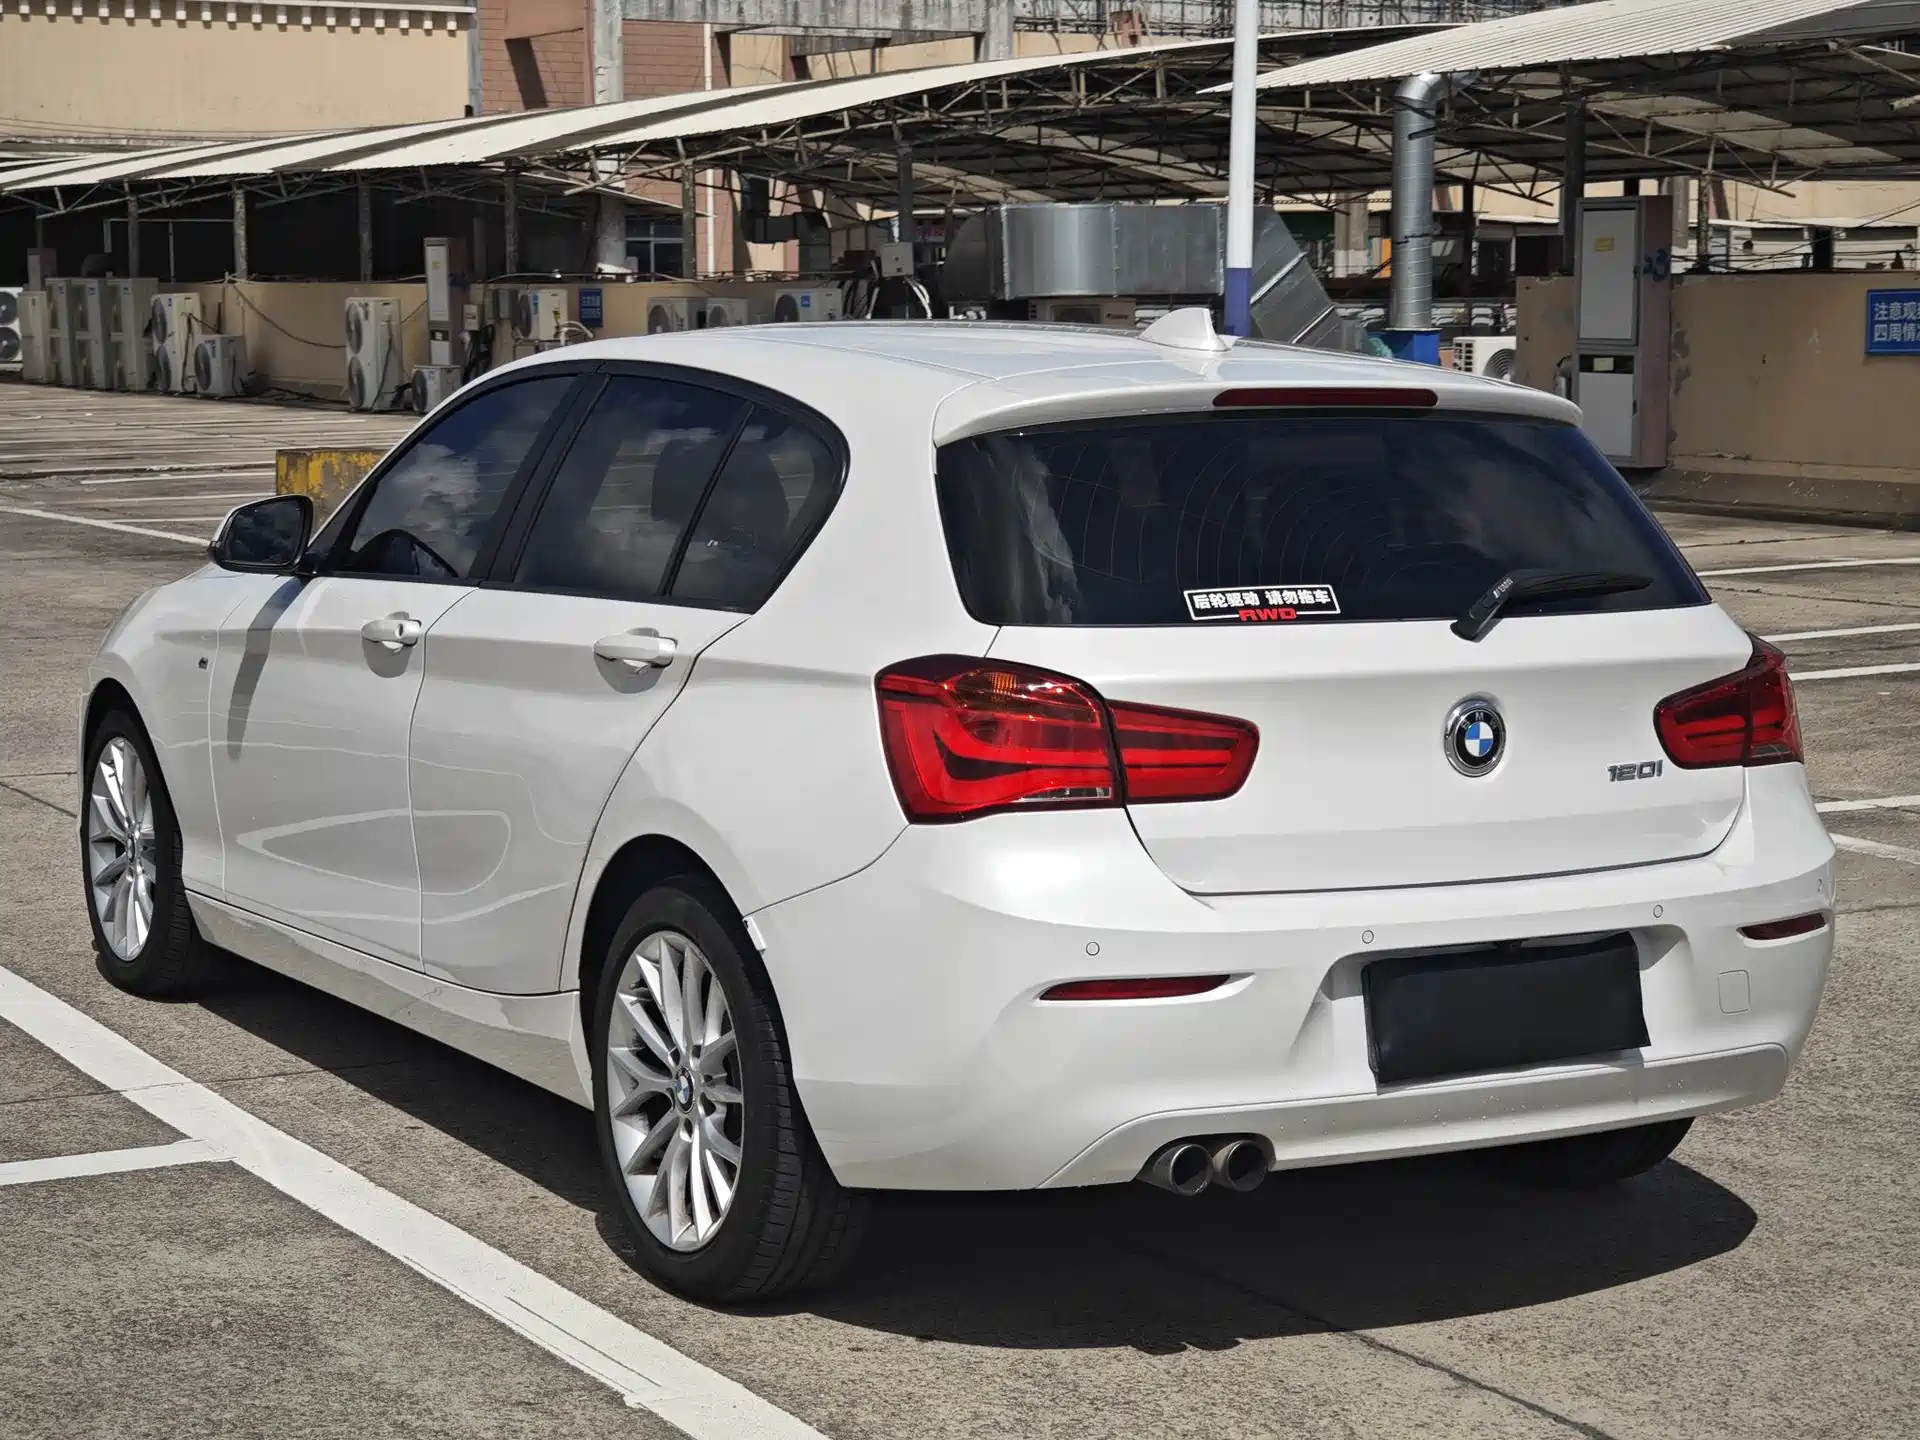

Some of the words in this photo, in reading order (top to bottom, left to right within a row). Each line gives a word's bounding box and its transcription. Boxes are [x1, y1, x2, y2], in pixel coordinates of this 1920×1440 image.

[1192, 591, 1260, 609] 后轮驱动
[1265, 589, 1331, 605] 请勿拖车
[1239, 608, 1297, 621] RWD
[1460, 711, 1499, 730] BMW
